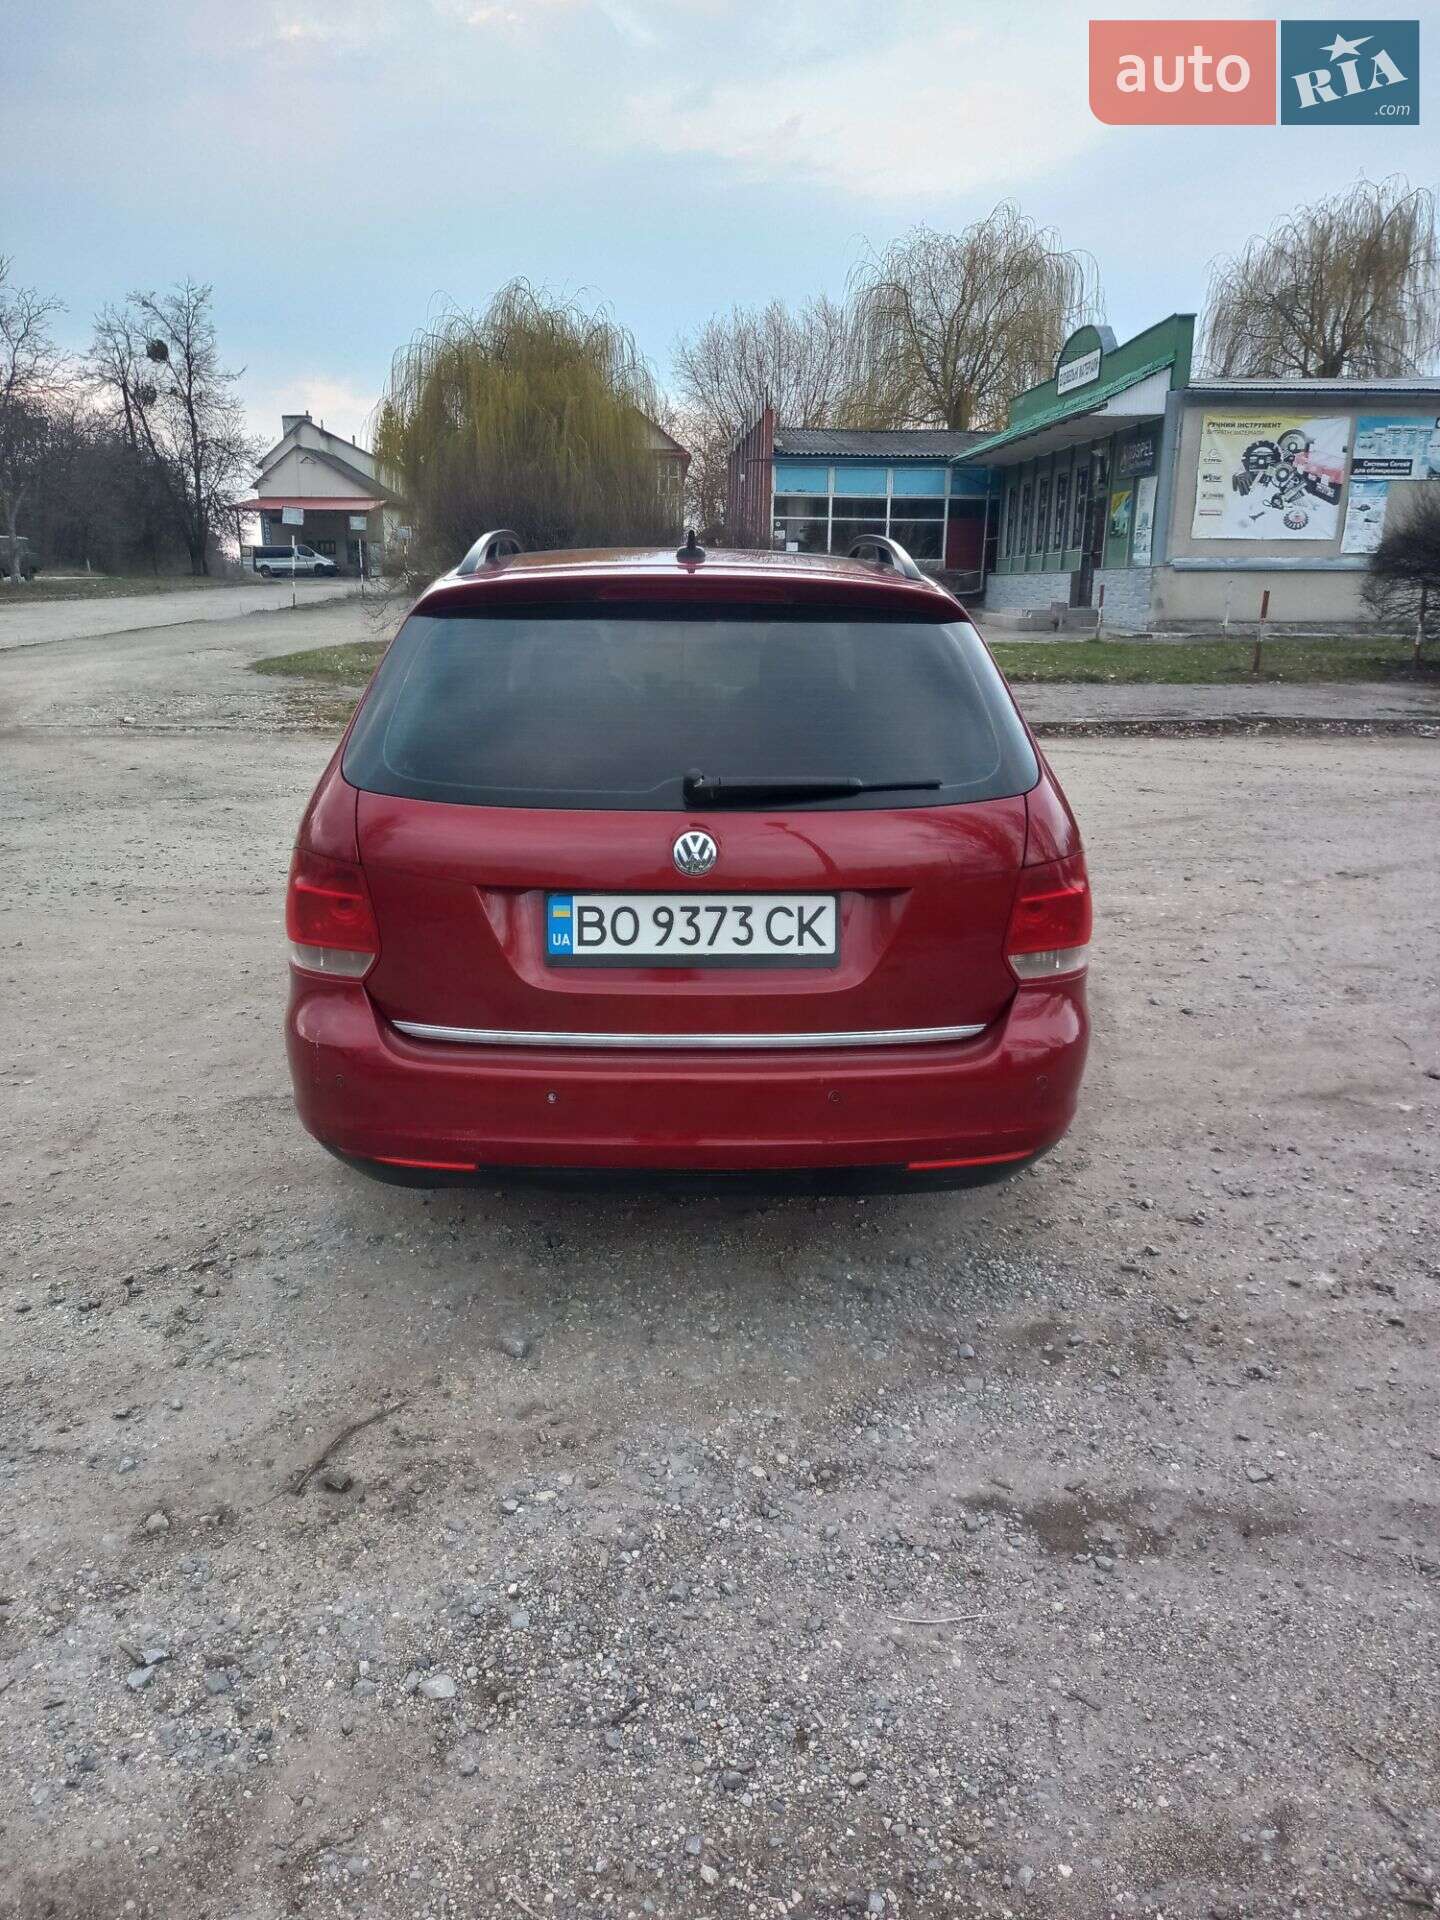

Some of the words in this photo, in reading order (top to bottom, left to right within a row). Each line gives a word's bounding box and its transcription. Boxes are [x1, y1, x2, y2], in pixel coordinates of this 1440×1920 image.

[553, 933, 570, 946] UA
[577, 906, 640, 947] BO
[652, 906, 754, 947] 9373
[765, 906, 827, 947] CK
